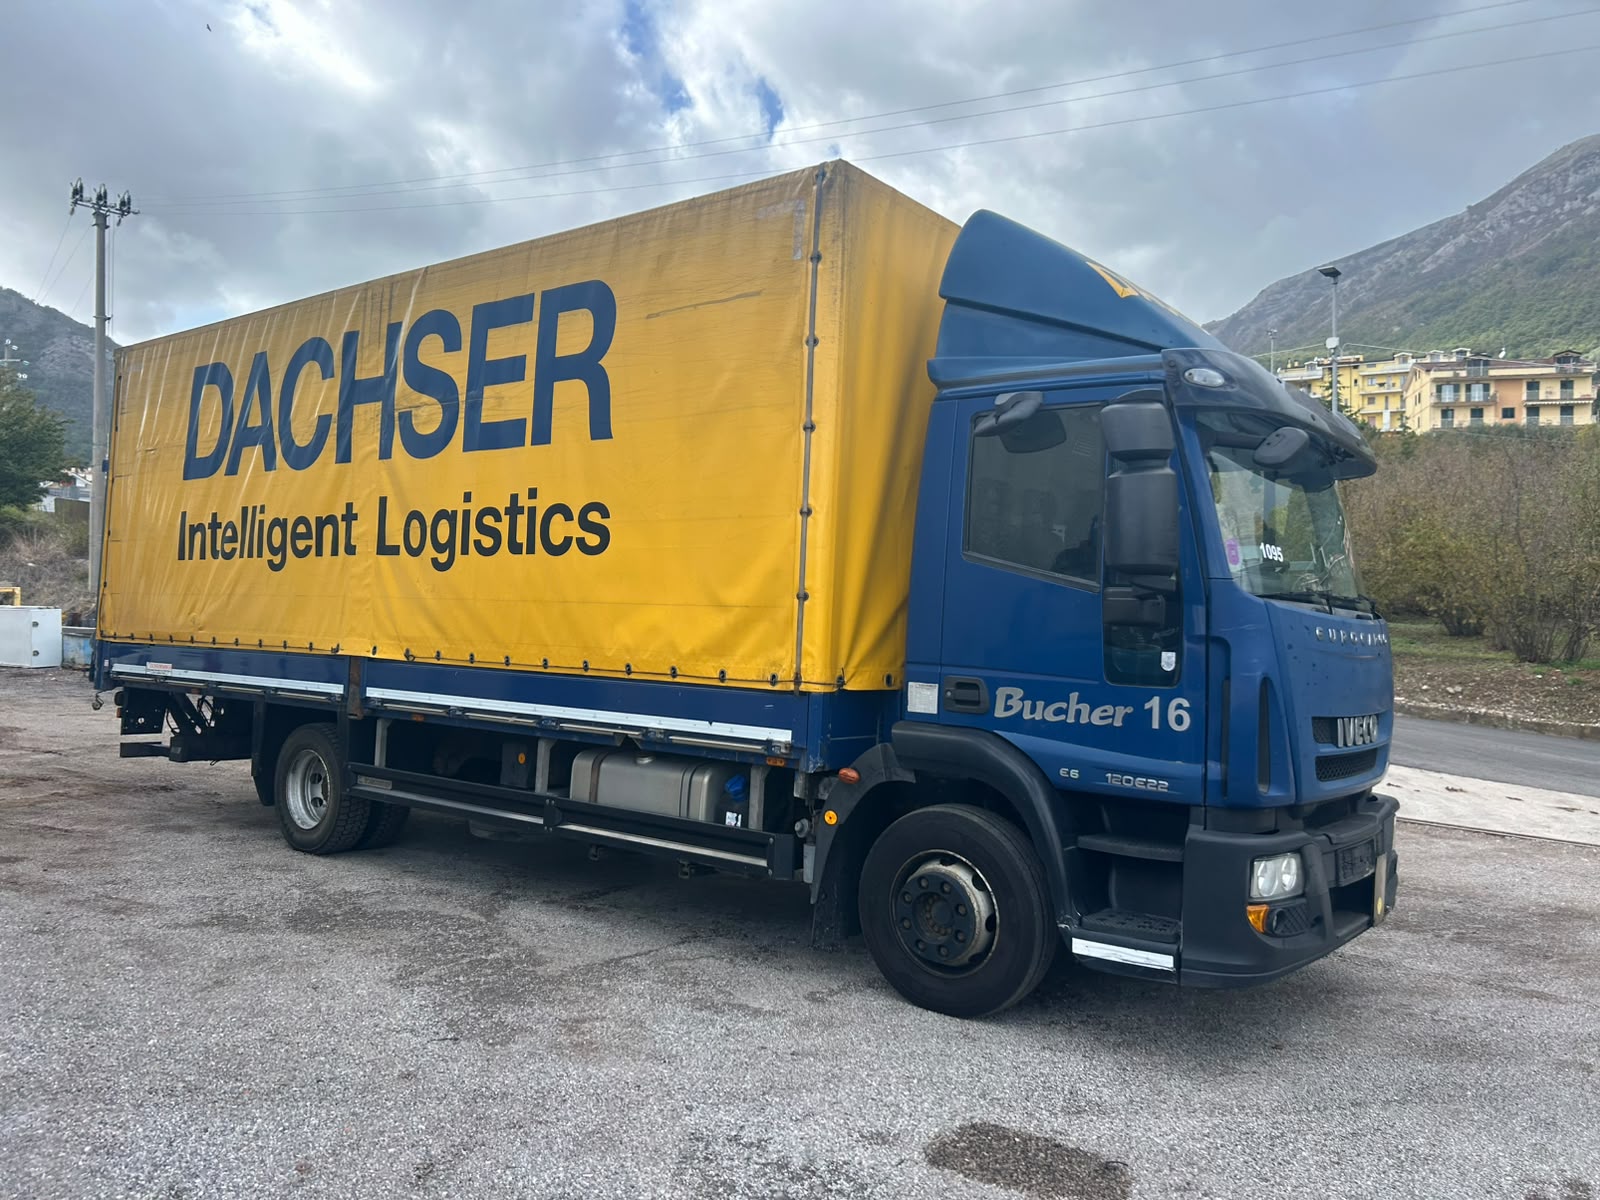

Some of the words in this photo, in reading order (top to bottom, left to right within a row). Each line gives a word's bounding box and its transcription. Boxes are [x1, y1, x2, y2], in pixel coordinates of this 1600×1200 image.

[183, 279, 617, 480] DACHSER
[177, 502, 357, 572] Intelligent
[376, 487, 611, 571] Logistics
[1260, 542, 1283, 562] 1095
[994, 686, 1133, 727] Bucher
[1144, 695, 1191, 732] 16
[1337, 714, 1377, 748] IVECO
[1059, 767, 1080, 779] E6
[1105, 773, 1169, 792] 120E22
